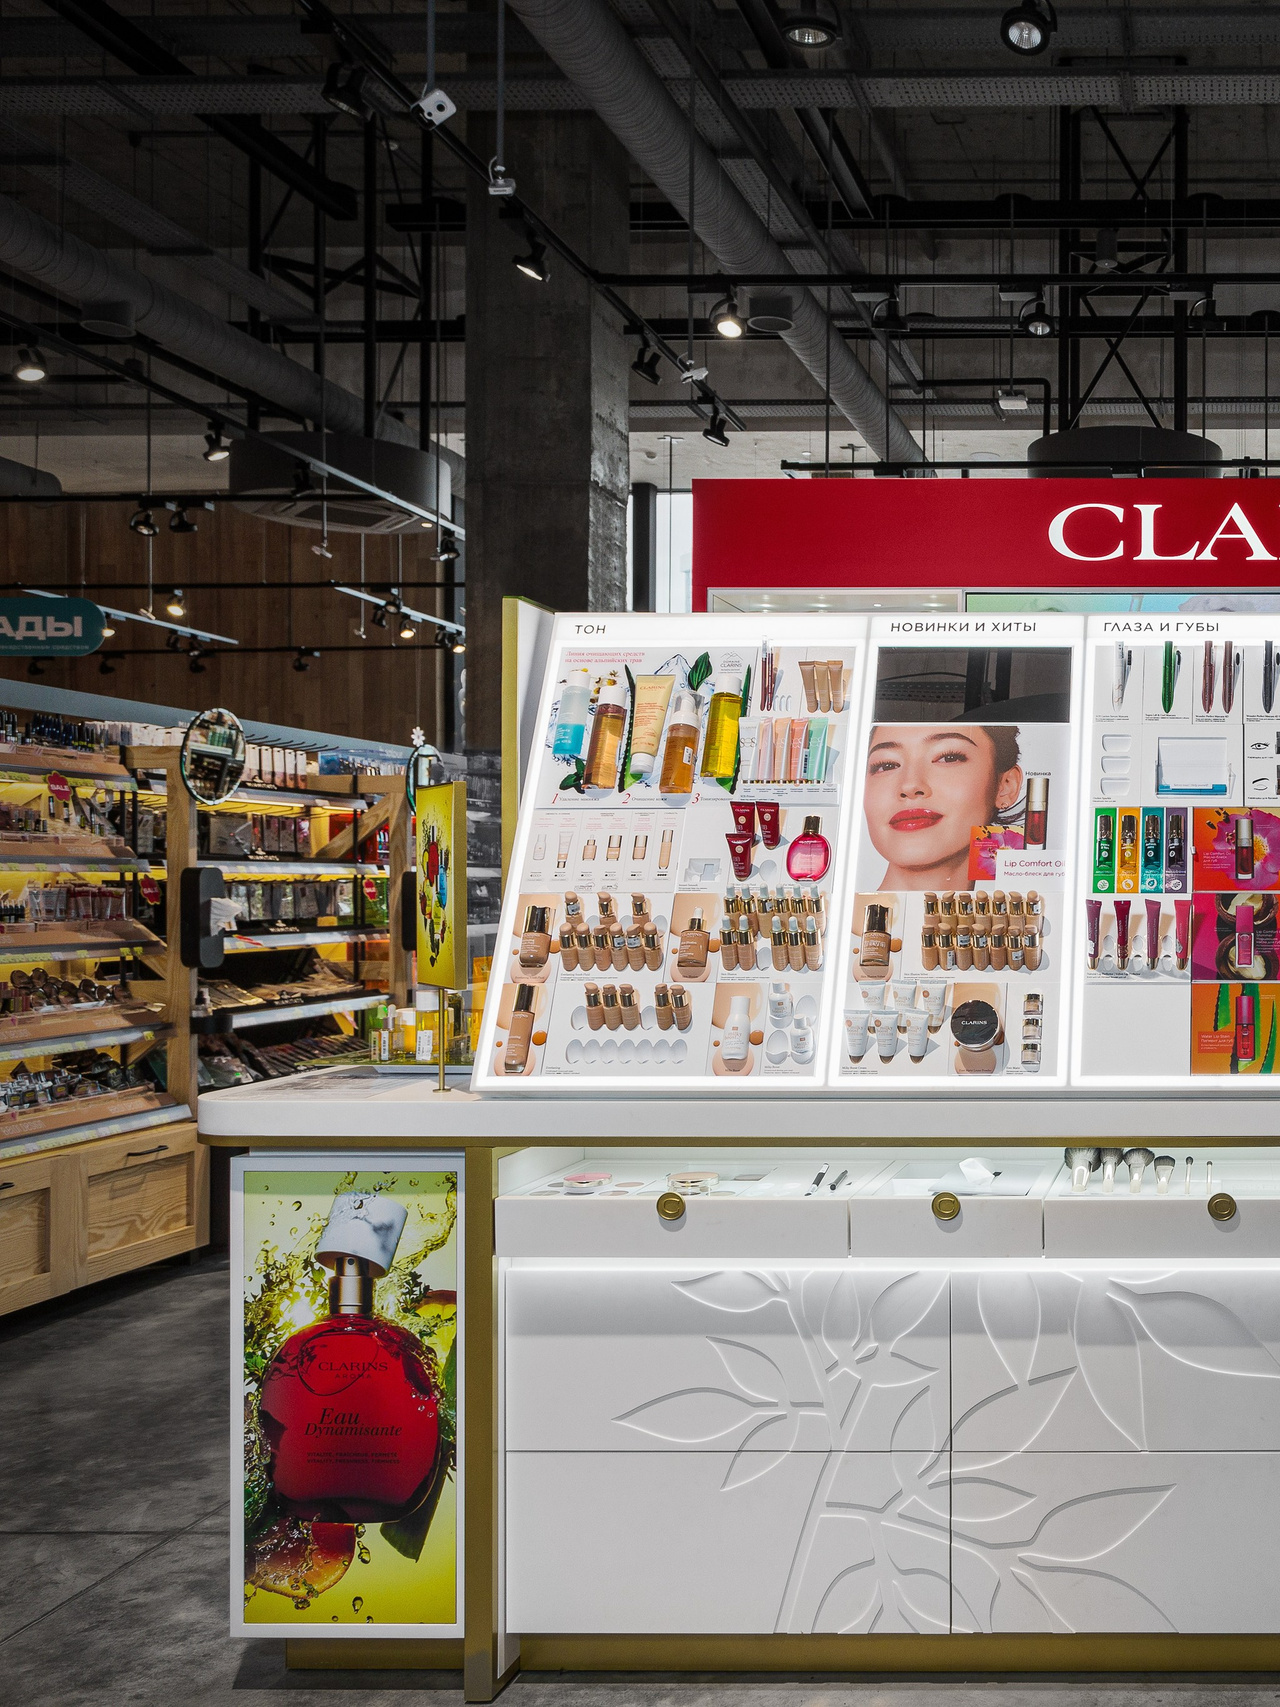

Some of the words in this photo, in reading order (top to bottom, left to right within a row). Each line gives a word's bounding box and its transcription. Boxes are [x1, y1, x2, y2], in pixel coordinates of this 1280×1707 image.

[574, 624, 607, 634] ТОН
[890, 622, 970, 632] НОВИНКИ
[974, 622, 986, 632] И
[991, 622, 1036, 632] ХИТЫ
[1103, 622, 1154, 632] ГЛАЗА
[1159, 622, 1171, 632] И
[1175, 622, 1220, 632] ГУБЫ
[1004, 860, 1017, 868] Lip
[318, 1362, 388, 1372] CLARINS
[319, 1407, 360, 1425] Eau
[304, 1422, 402, 1438] Dynamisante
